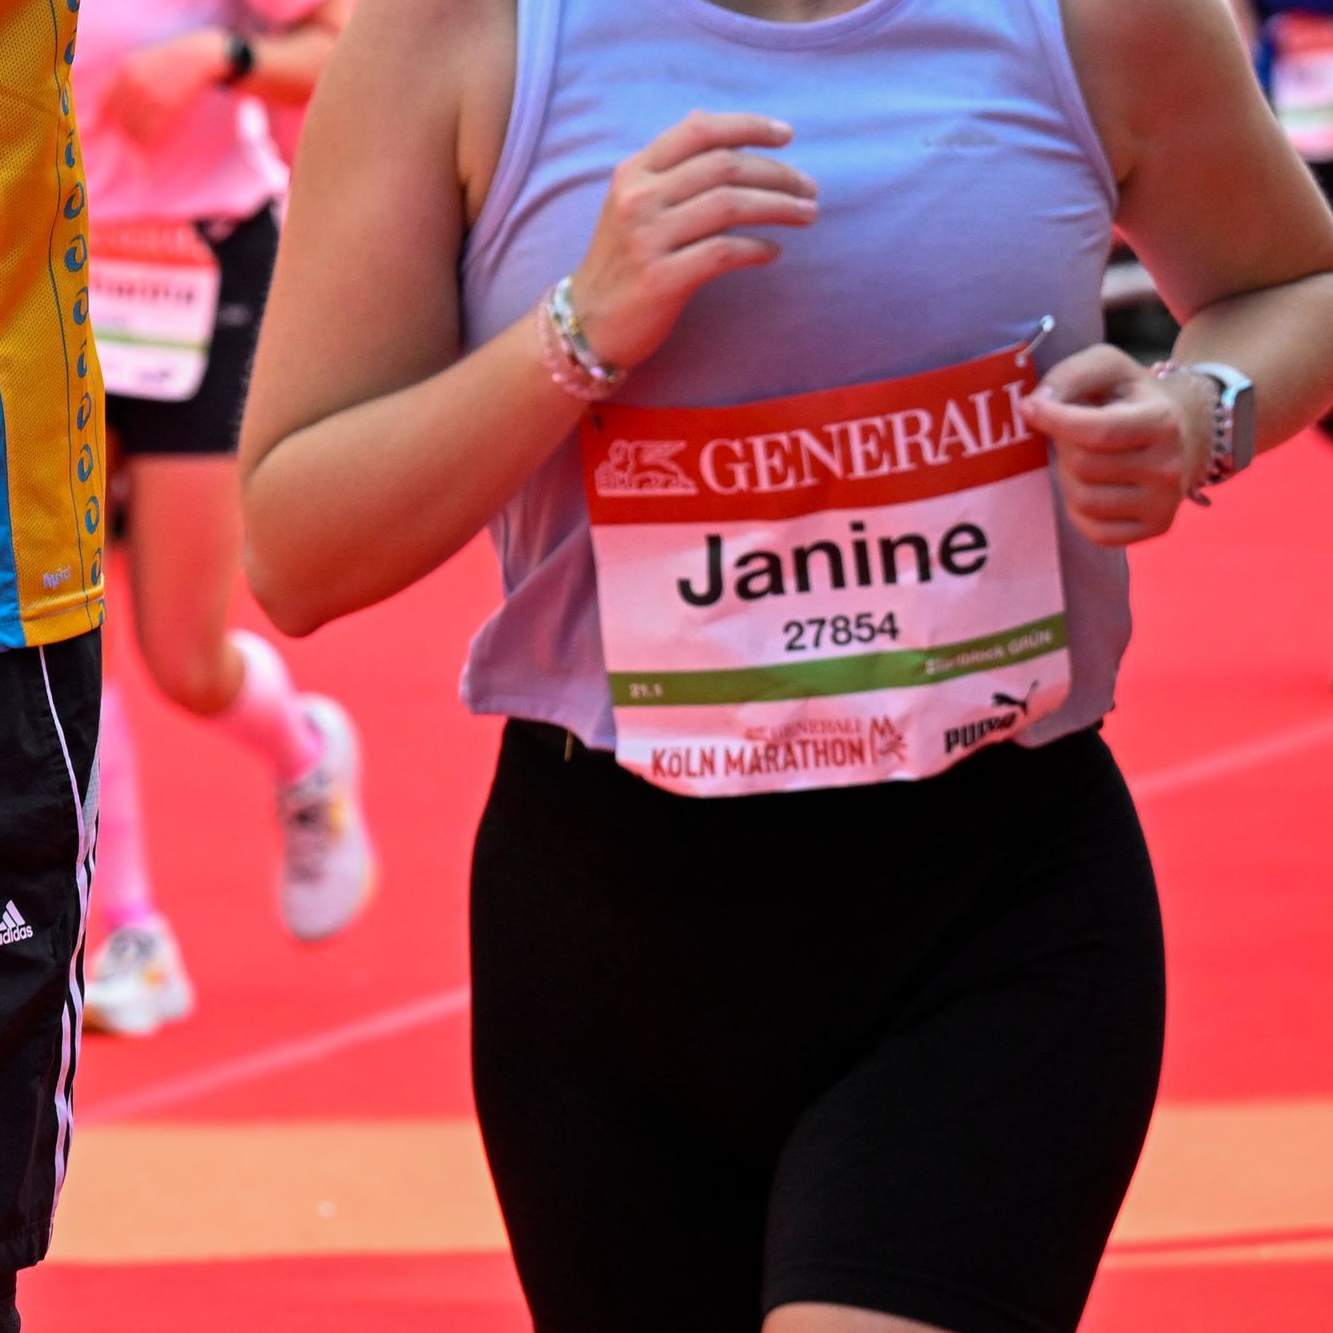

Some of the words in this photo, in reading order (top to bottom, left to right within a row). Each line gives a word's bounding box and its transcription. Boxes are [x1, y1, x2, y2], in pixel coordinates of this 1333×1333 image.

[699, 379, 1032, 497] GENERALI
[677, 522, 988, 608] Janine
[783, 612, 900, 653] 27854
[650, 746, 716, 778] KÖLN
[724, 736, 865, 777] MARATHON
